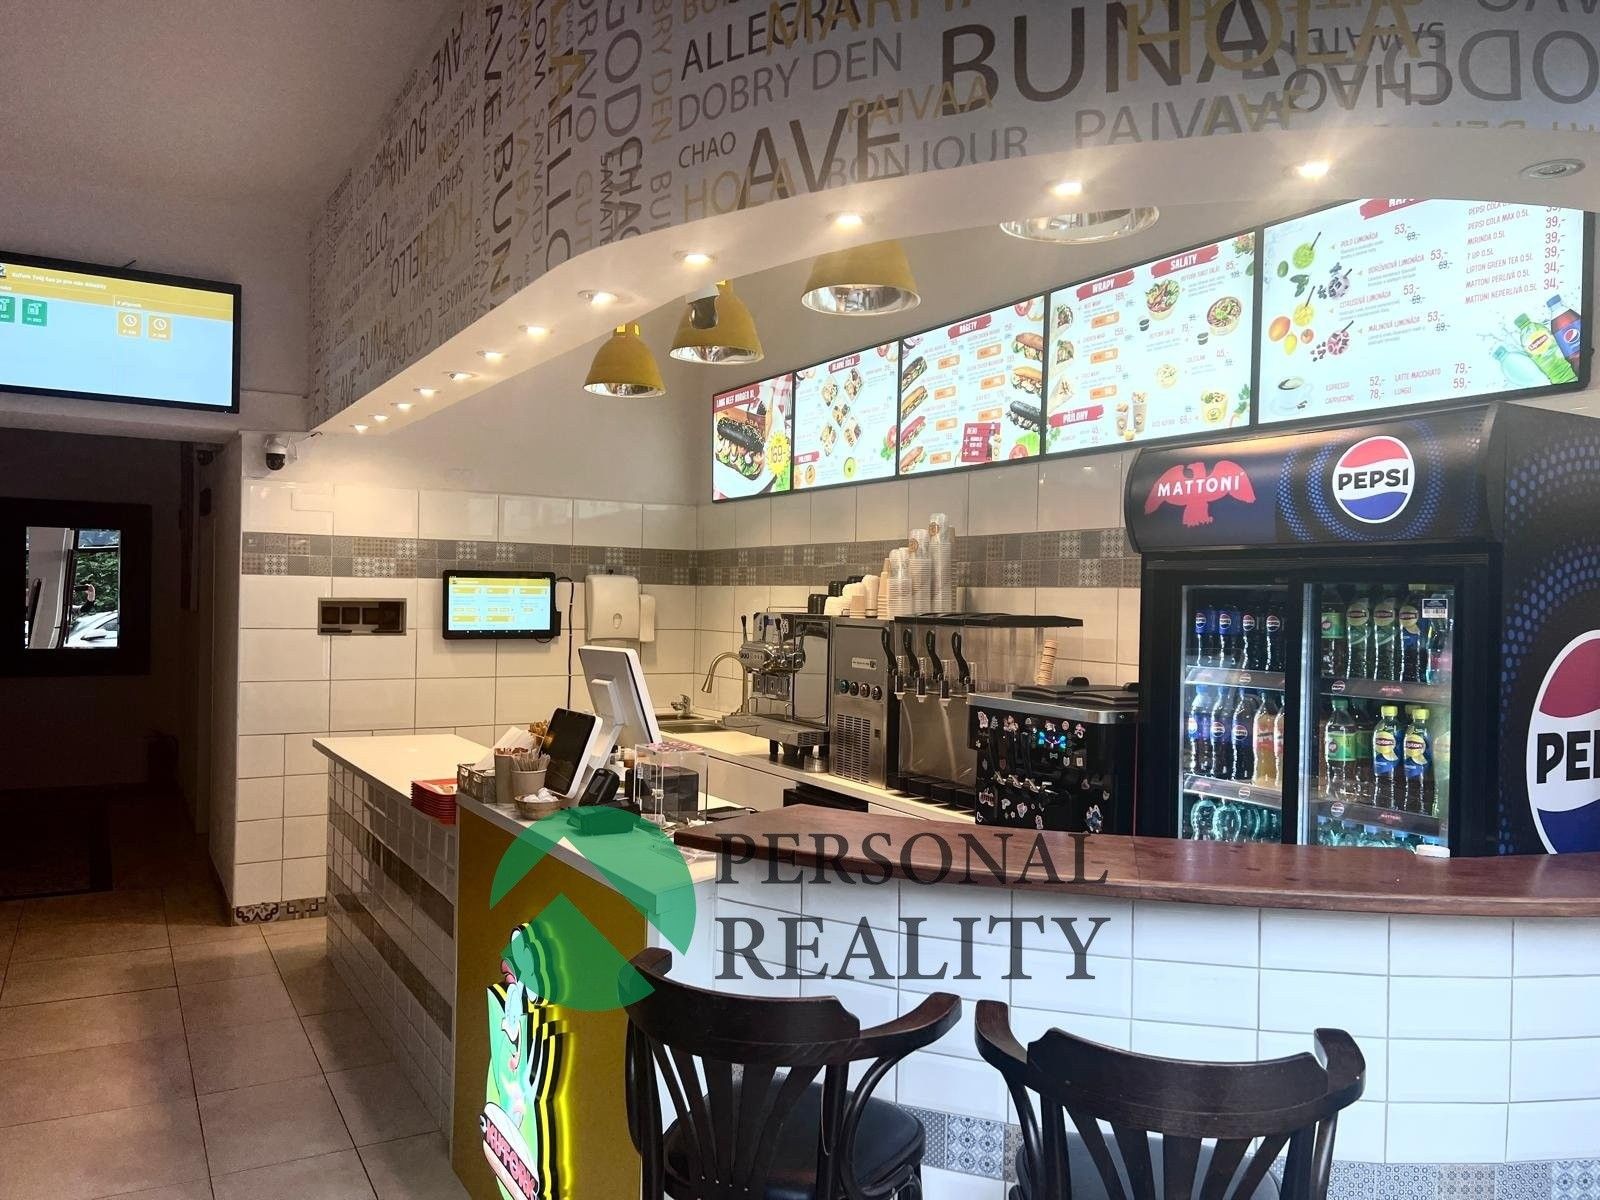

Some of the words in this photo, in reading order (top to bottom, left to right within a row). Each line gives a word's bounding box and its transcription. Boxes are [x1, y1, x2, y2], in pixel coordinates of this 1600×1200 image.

[679, 58, 800, 132] DOBRY
[812, 32, 903, 91] DEN
[651, 68, 673, 144] DEN
[847, 75, 993, 135] PAIVAA
[678, 131, 737, 169] CHAO
[737, 97, 902, 211] AVE
[1467, 235, 1492, 246] MIRINDA
[1092, 278, 1115, 294] WRAPY
[1157, 474, 1242, 498] MATTONI
[1337, 467, 1410, 492] PEPSI
